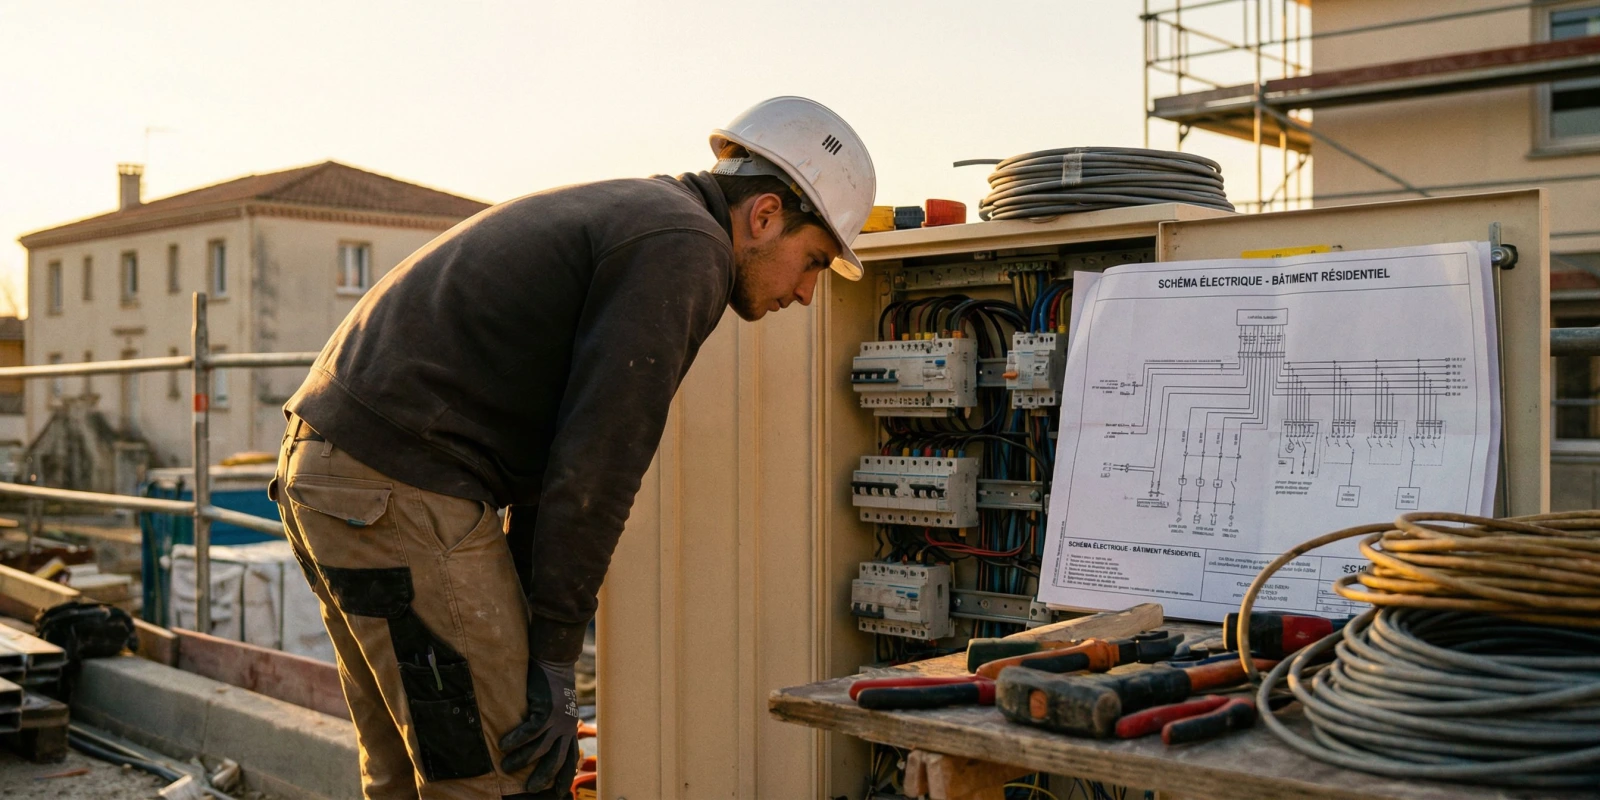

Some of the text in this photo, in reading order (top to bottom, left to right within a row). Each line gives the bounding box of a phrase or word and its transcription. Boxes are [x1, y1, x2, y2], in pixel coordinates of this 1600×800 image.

[1158, 276, 1197, 289] SCHÉMA
[1199, 274, 1262, 288] ÉLECTRIQUE
[1271, 271, 1319, 286] BÂTIMENT
[1321, 267, 1390, 282] RÉSIDENTIEL
[1068, 540, 1091, 549] SCHÉMA
[1093, 542, 1128, 552] ÉLECTRIQUE
[1132, 545, 1162, 555] BÂTIMENT
[1163, 548, 1201, 558] RÉSIDENTIEL
